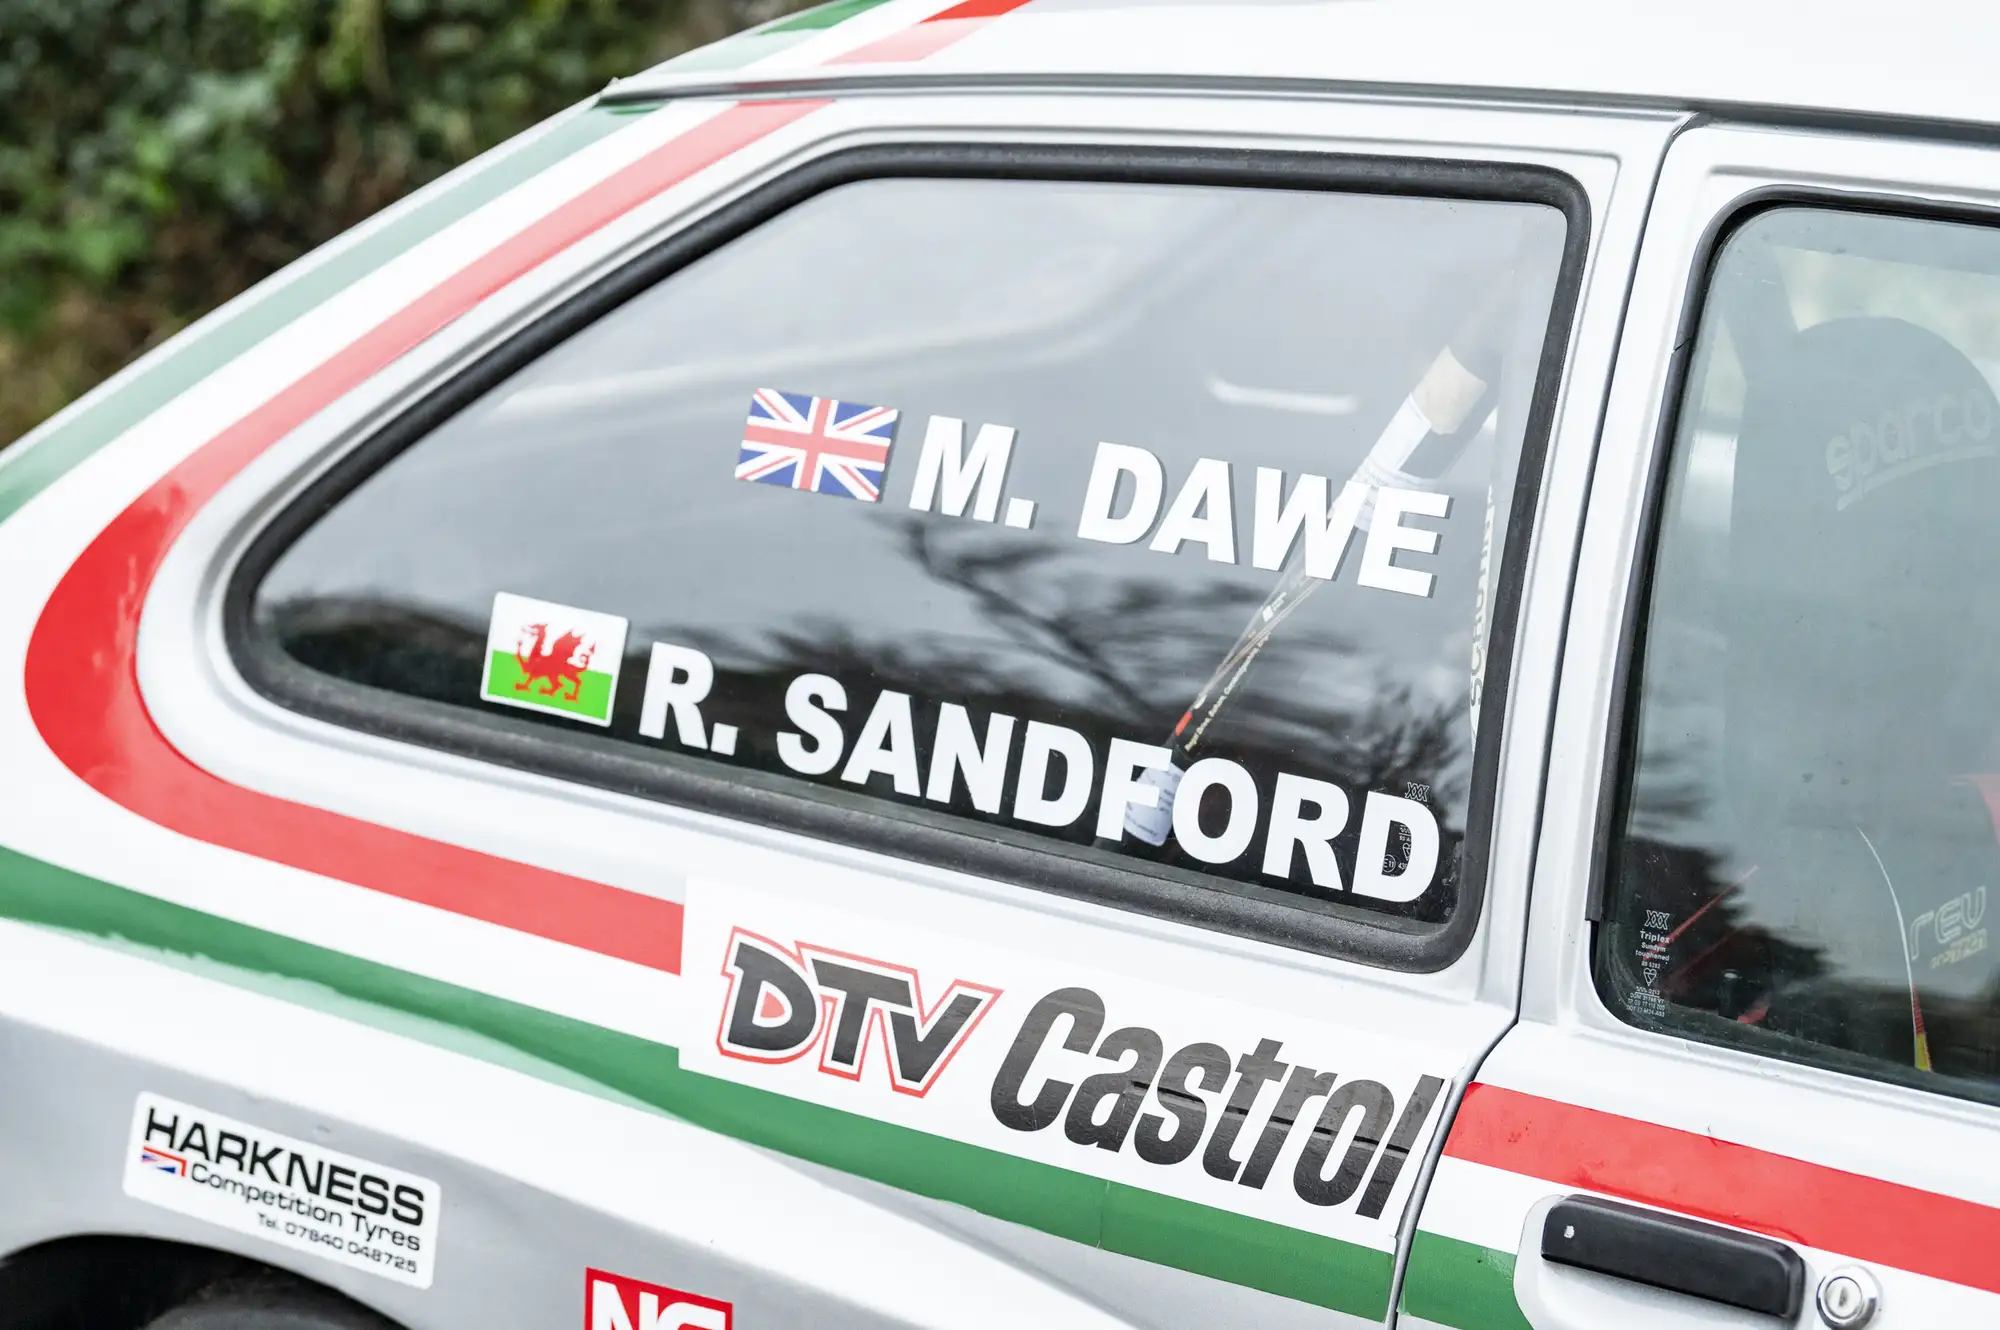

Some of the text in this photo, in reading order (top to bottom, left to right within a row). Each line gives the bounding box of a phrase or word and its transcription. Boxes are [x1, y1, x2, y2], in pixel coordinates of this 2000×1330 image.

[909, 415, 1035, 529] M.
[1077, 441, 1450, 598] DAWE
[638, 642, 739, 756] R.
[776, 673, 1440, 902] SANDFORD
[1640, 929, 1670, 944] Triplex
[717, 926, 1004, 1097] DTV
[145, 1108, 425, 1226] HARKNESS
[990, 987, 1444, 1220] Castrol
[191, 1163, 421, 1251] Competition Tyres
[286, 1222, 343, 1250] 07840
[347, 1241, 417, 1273] 048725
